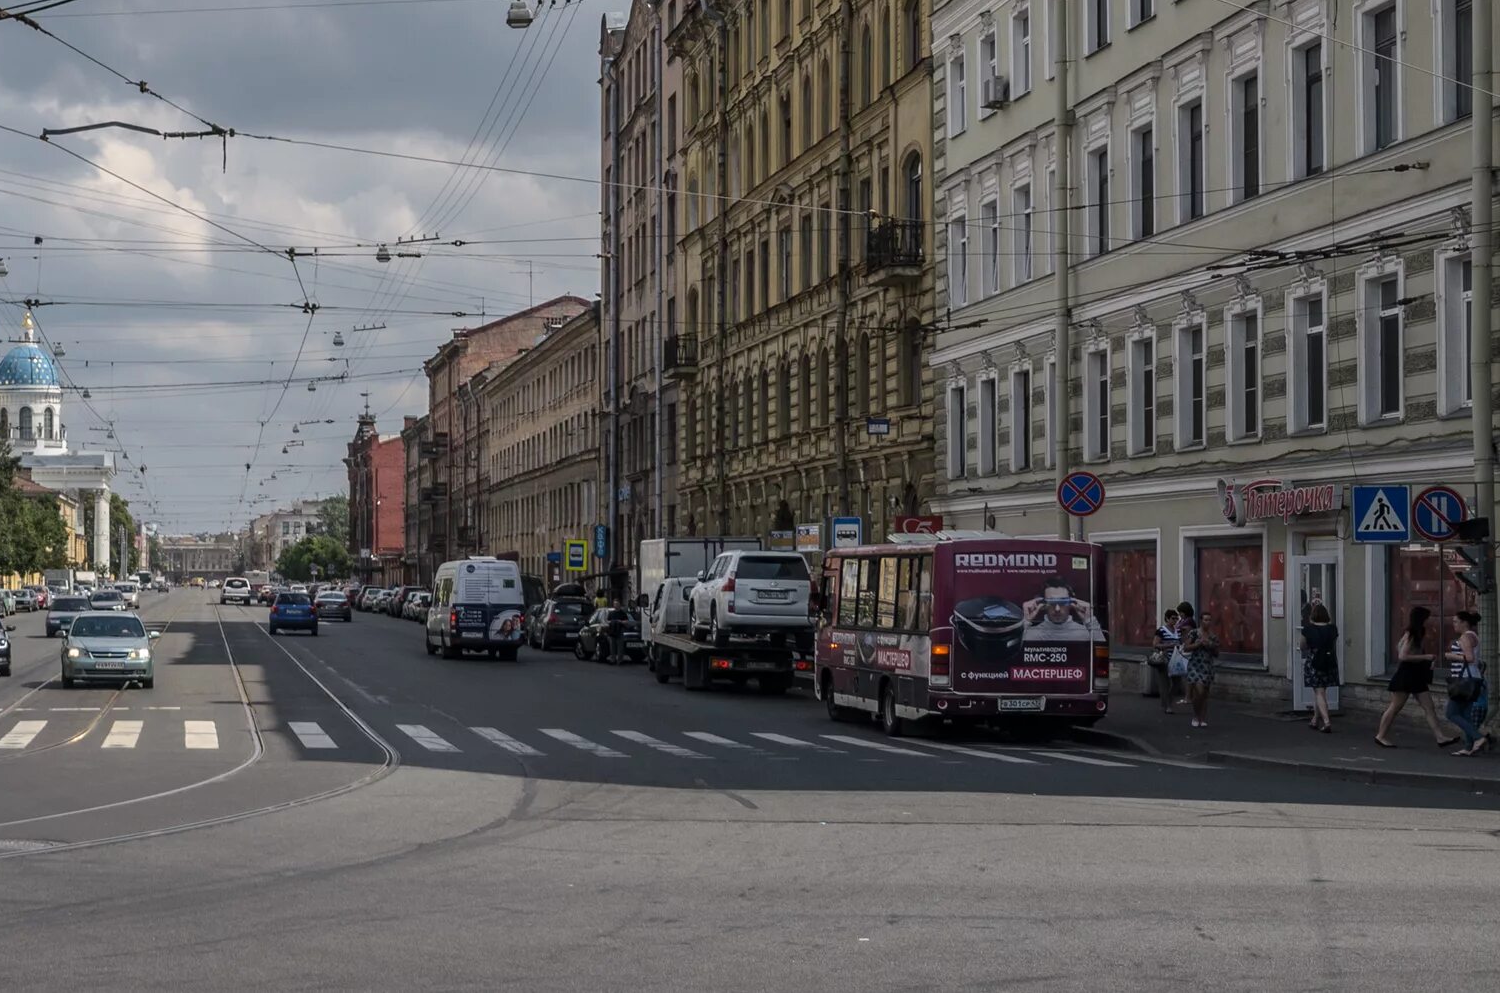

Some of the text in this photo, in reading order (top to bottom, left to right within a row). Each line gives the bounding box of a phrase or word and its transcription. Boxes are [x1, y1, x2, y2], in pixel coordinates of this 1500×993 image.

[1024, 653, 1067, 662] RMC-250
[968, 671, 1009, 680] функцией
[1013, 668, 1083, 679] МАСТЕРШЕФ
